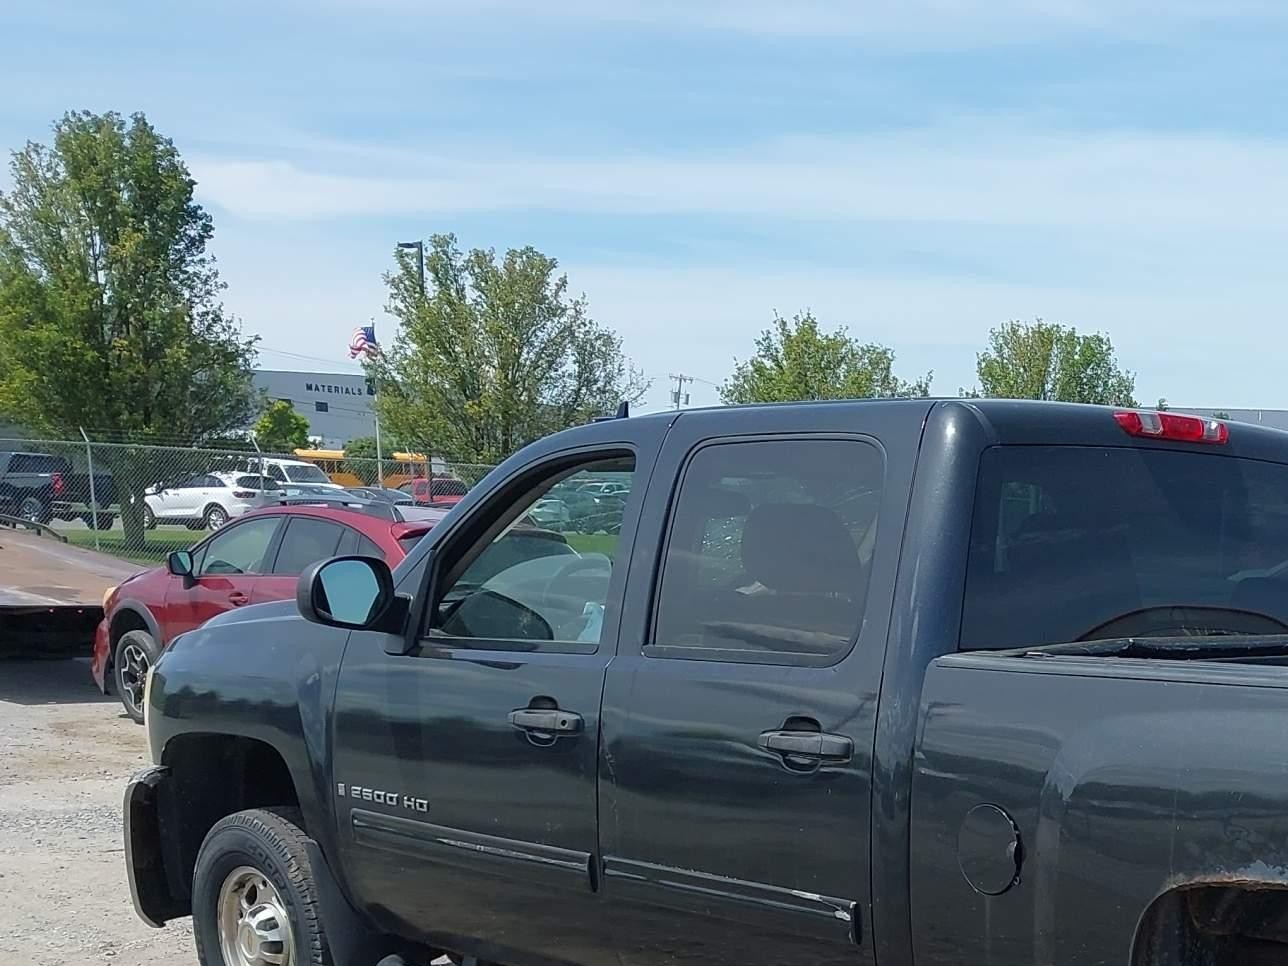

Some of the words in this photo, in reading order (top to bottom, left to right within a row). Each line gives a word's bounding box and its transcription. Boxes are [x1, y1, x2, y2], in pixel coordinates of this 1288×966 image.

[305, 383, 363, 396] MATERIALS
[351, 786, 399, 806] 2500
[403, 795, 429, 812] HD
